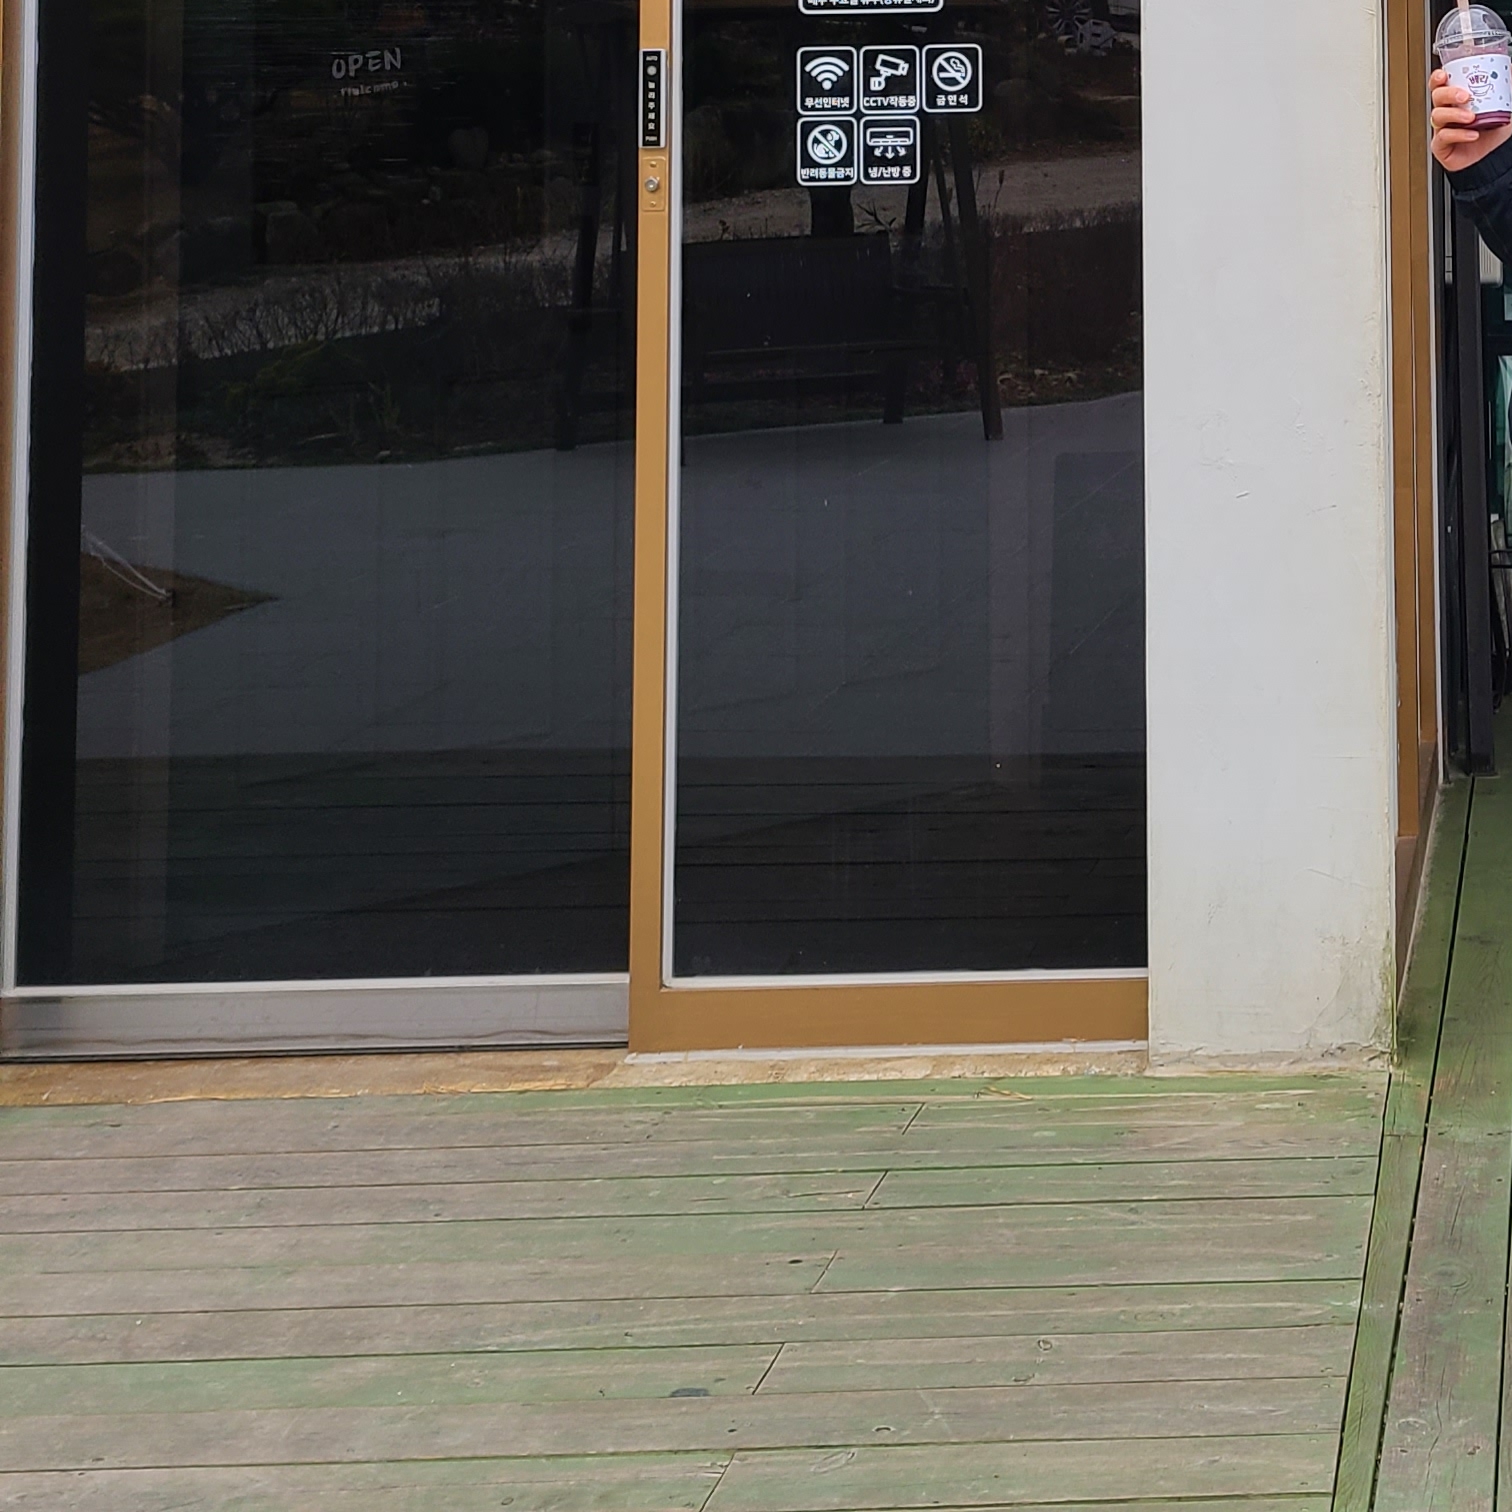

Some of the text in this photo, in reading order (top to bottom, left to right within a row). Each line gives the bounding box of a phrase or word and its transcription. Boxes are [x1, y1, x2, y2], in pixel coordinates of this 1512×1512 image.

[331, 48, 401, 80] OPEN
[804, 96, 850, 108] 무선인터넷
[863, 95, 916, 108] CCTV작동중
[801, 167, 854, 180] 반려동물금지
